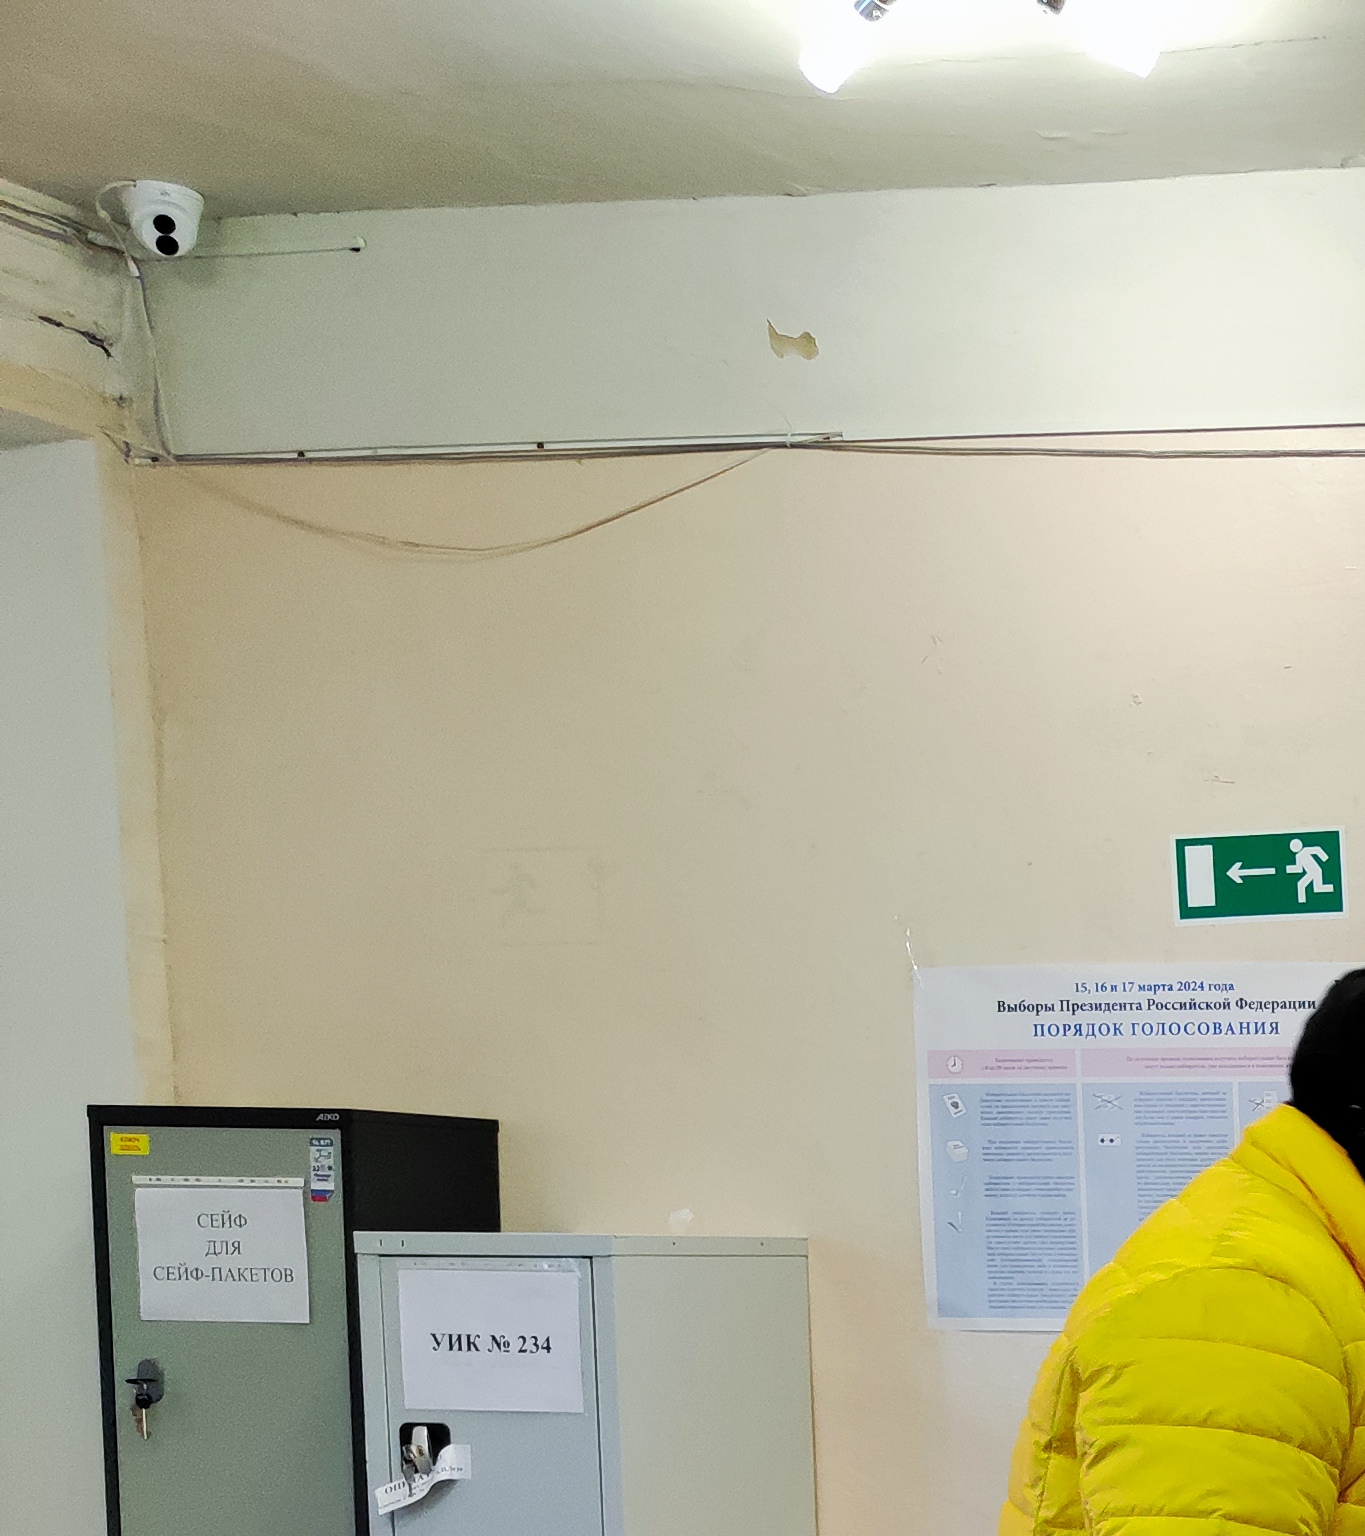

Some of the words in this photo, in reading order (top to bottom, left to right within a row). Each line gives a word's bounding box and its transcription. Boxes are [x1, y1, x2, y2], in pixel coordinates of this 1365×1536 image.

[1074, 982, 1092, 994] 15,
[1094, 982, 1108, 993] 16
[1110, 984, 1119, 993] и
[1122, 981, 1135, 993] 17
[1137, 983, 1174, 996] марта
[1176, 981, 1205, 992] 2024
[1207, 983, 1235, 994] года
[997, 1000, 1055, 1016] Выборы
[1059, 999, 1143, 1015] Президента
[1146, 998, 1231, 1012] Российской
[1235, 997, 1317, 1014] Федерации
[1033, 1022, 1124, 1038] ПОРЯДОК
[1131, 1020, 1280, 1037] ГОЛОСОВАНИЯ
[196, 1210, 248, 1229] СЕЙФ
[204, 1240, 242, 1257] ДЛЯ
[153, 1262, 294, 1283] СЕЙФ-ПАКЕТОВ
[430, 1333, 481, 1352] УИК
[487, 1334, 511, 1353] №
[517, 1335, 552, 1354] 234
